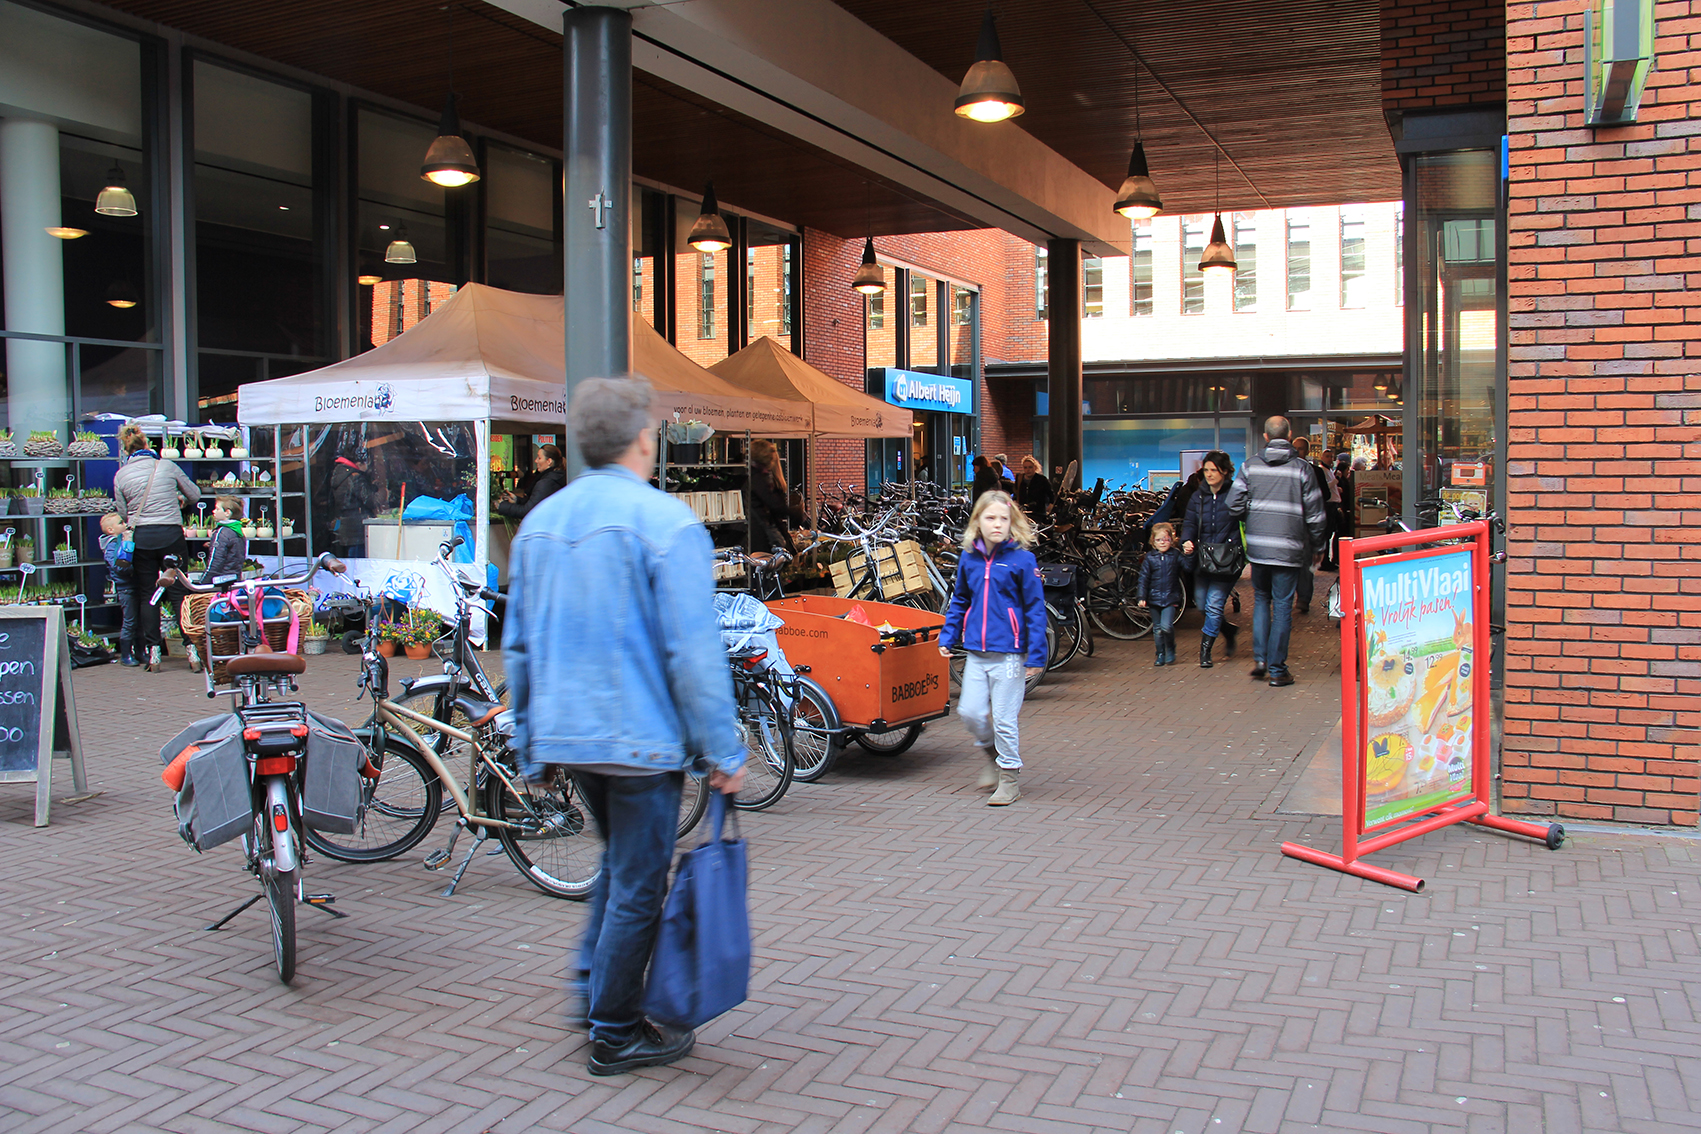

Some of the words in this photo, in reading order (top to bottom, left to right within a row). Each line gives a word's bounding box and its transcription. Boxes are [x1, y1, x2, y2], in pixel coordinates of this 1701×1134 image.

[909, 380, 937, 401] Albert
[938, 385, 961, 407] Heijn
[673, 406, 687, 414] voor
[1418, 586, 1458, 622] pasen!
[774, 626, 829, 639] abboe.com
[892, 680, 929, 703] BABBOE
[926, 673, 939, 690] Big
